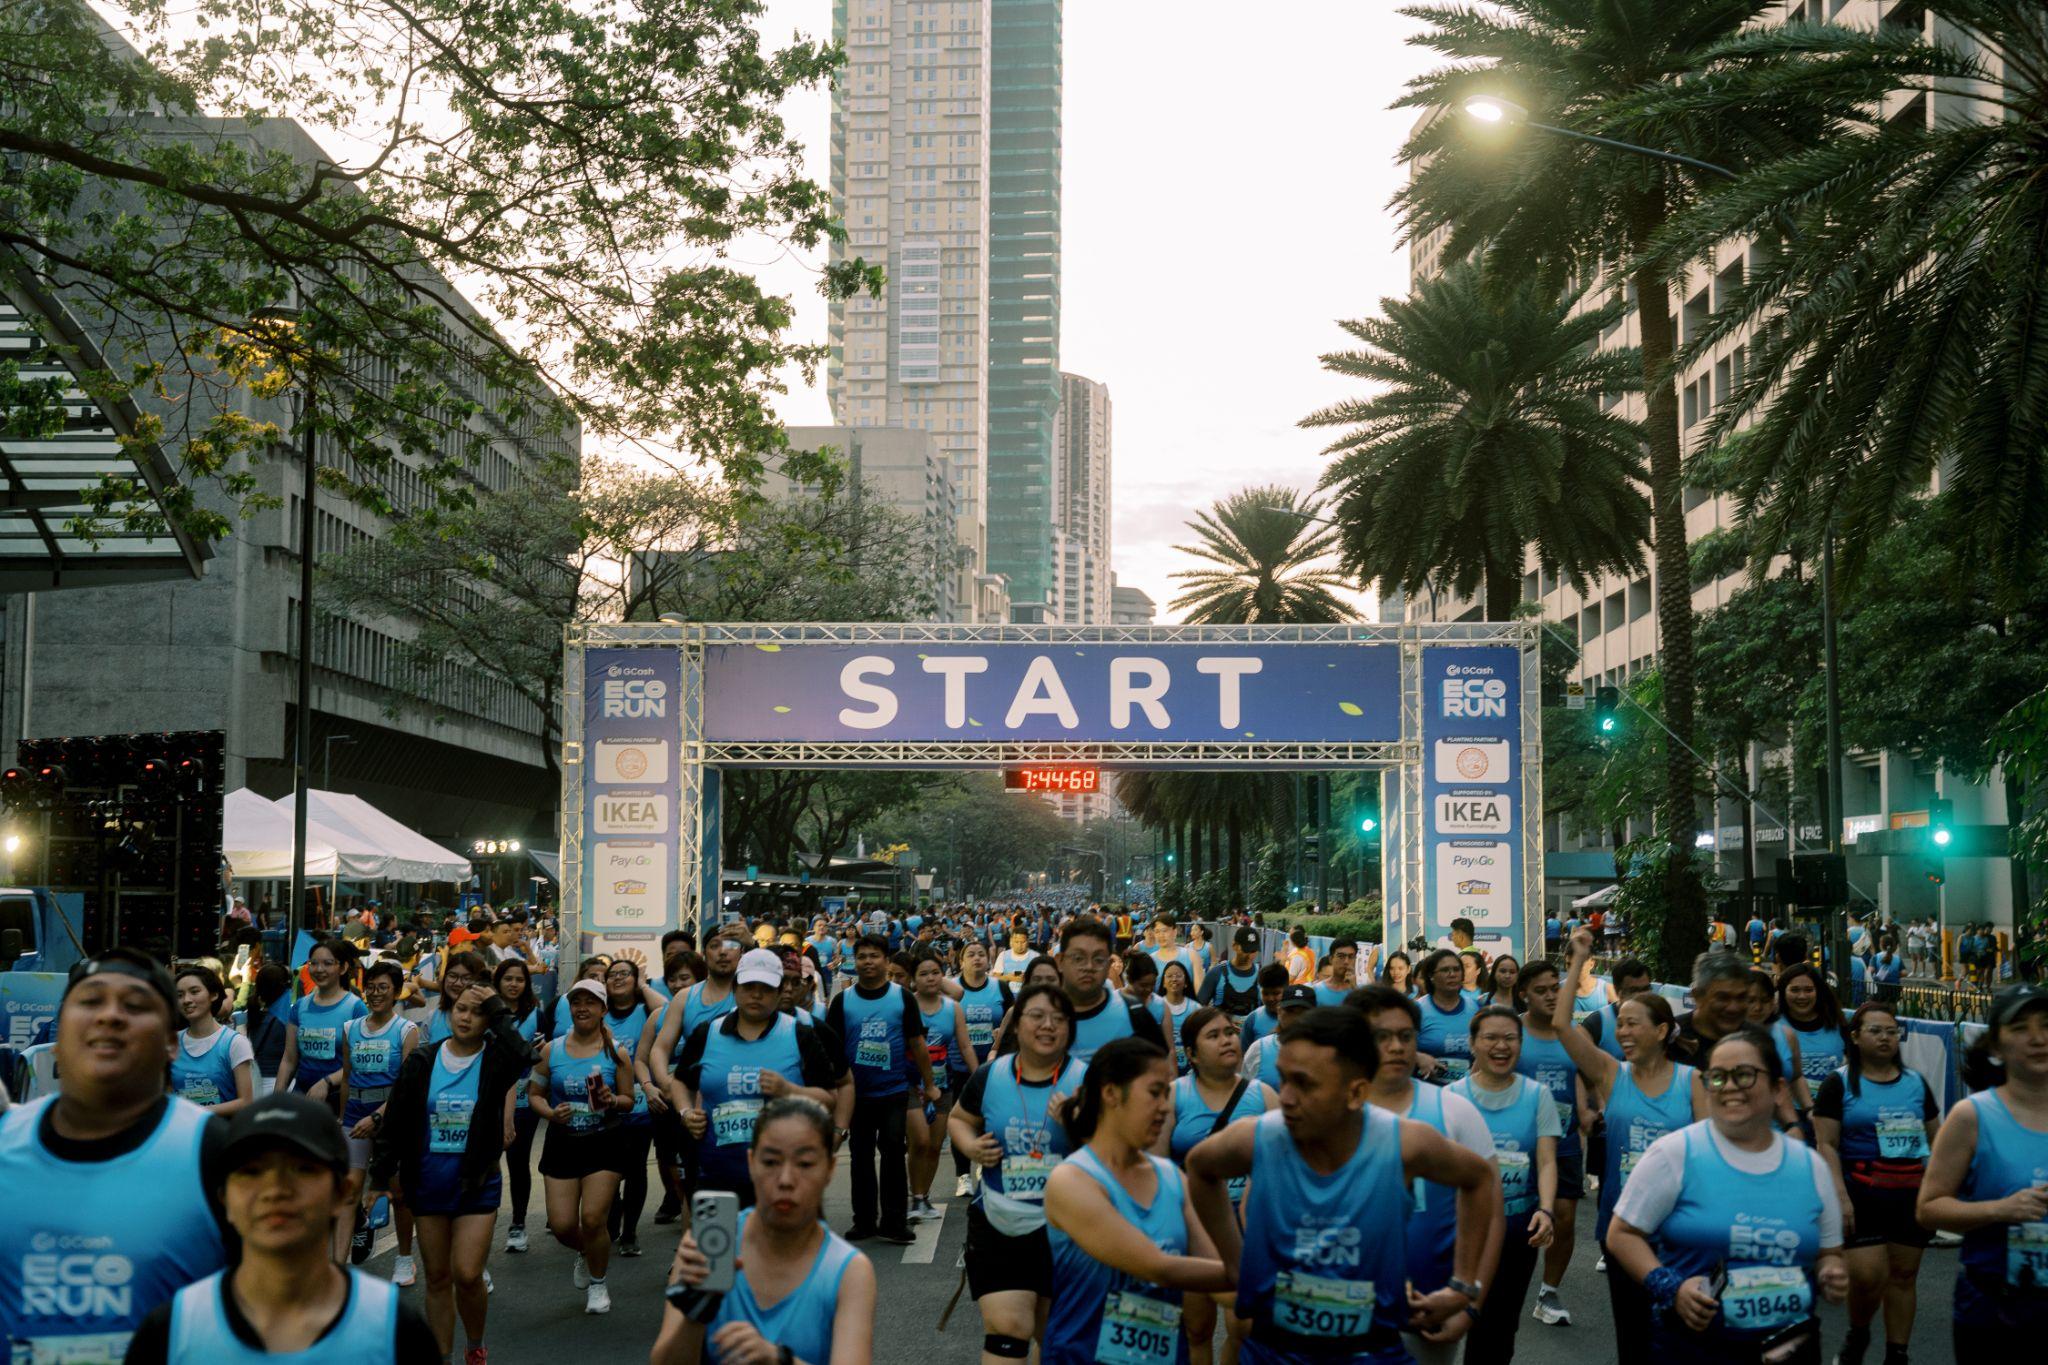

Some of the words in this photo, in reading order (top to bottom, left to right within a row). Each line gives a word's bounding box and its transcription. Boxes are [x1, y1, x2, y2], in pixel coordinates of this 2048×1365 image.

[623, 666, 655, 676] GCash
[1461, 665, 1494, 675] GCash
[604, 680, 667, 699] ECO
[838, 655, 1263, 730] START
[1443, 679, 1506, 698] ECO
[604, 699, 666, 718] RUN
[1443, 698, 1506, 717] RUN
[602, 802, 658, 822] IKEA
[1444, 802, 1501, 822] IKEA
[615, 905, 644, 918] eTap
[1460, 905, 1489, 919] eTap
[303, 1041, 330, 1051] 31012
[356, 1053, 384, 1064] 31010
[859, 1051, 888, 1063] 32650
[727, 1072, 761, 1084] EC
[1535, 1071, 1568, 1080] ECO
[438, 1129, 467, 1142] 3169
[1005, 1127, 1052, 1143] ECO
[1008, 1176, 1047, 1192] 3299
[1296, 1226, 1362, 1248] ECO
[1729, 1225, 1800, 1249] ECO
[1293, 1245, 1361, 1266] RUN
[1728, 1243, 1798, 1266] RUN
[22, 1253, 133, 1285] ECO
[22, 1285, 131, 1316] RUN
[1733, 1293, 1803, 1319] 31848
[1283, 1301, 1362, 1335] 33017
[1109, 1321, 1171, 1358] 33015
